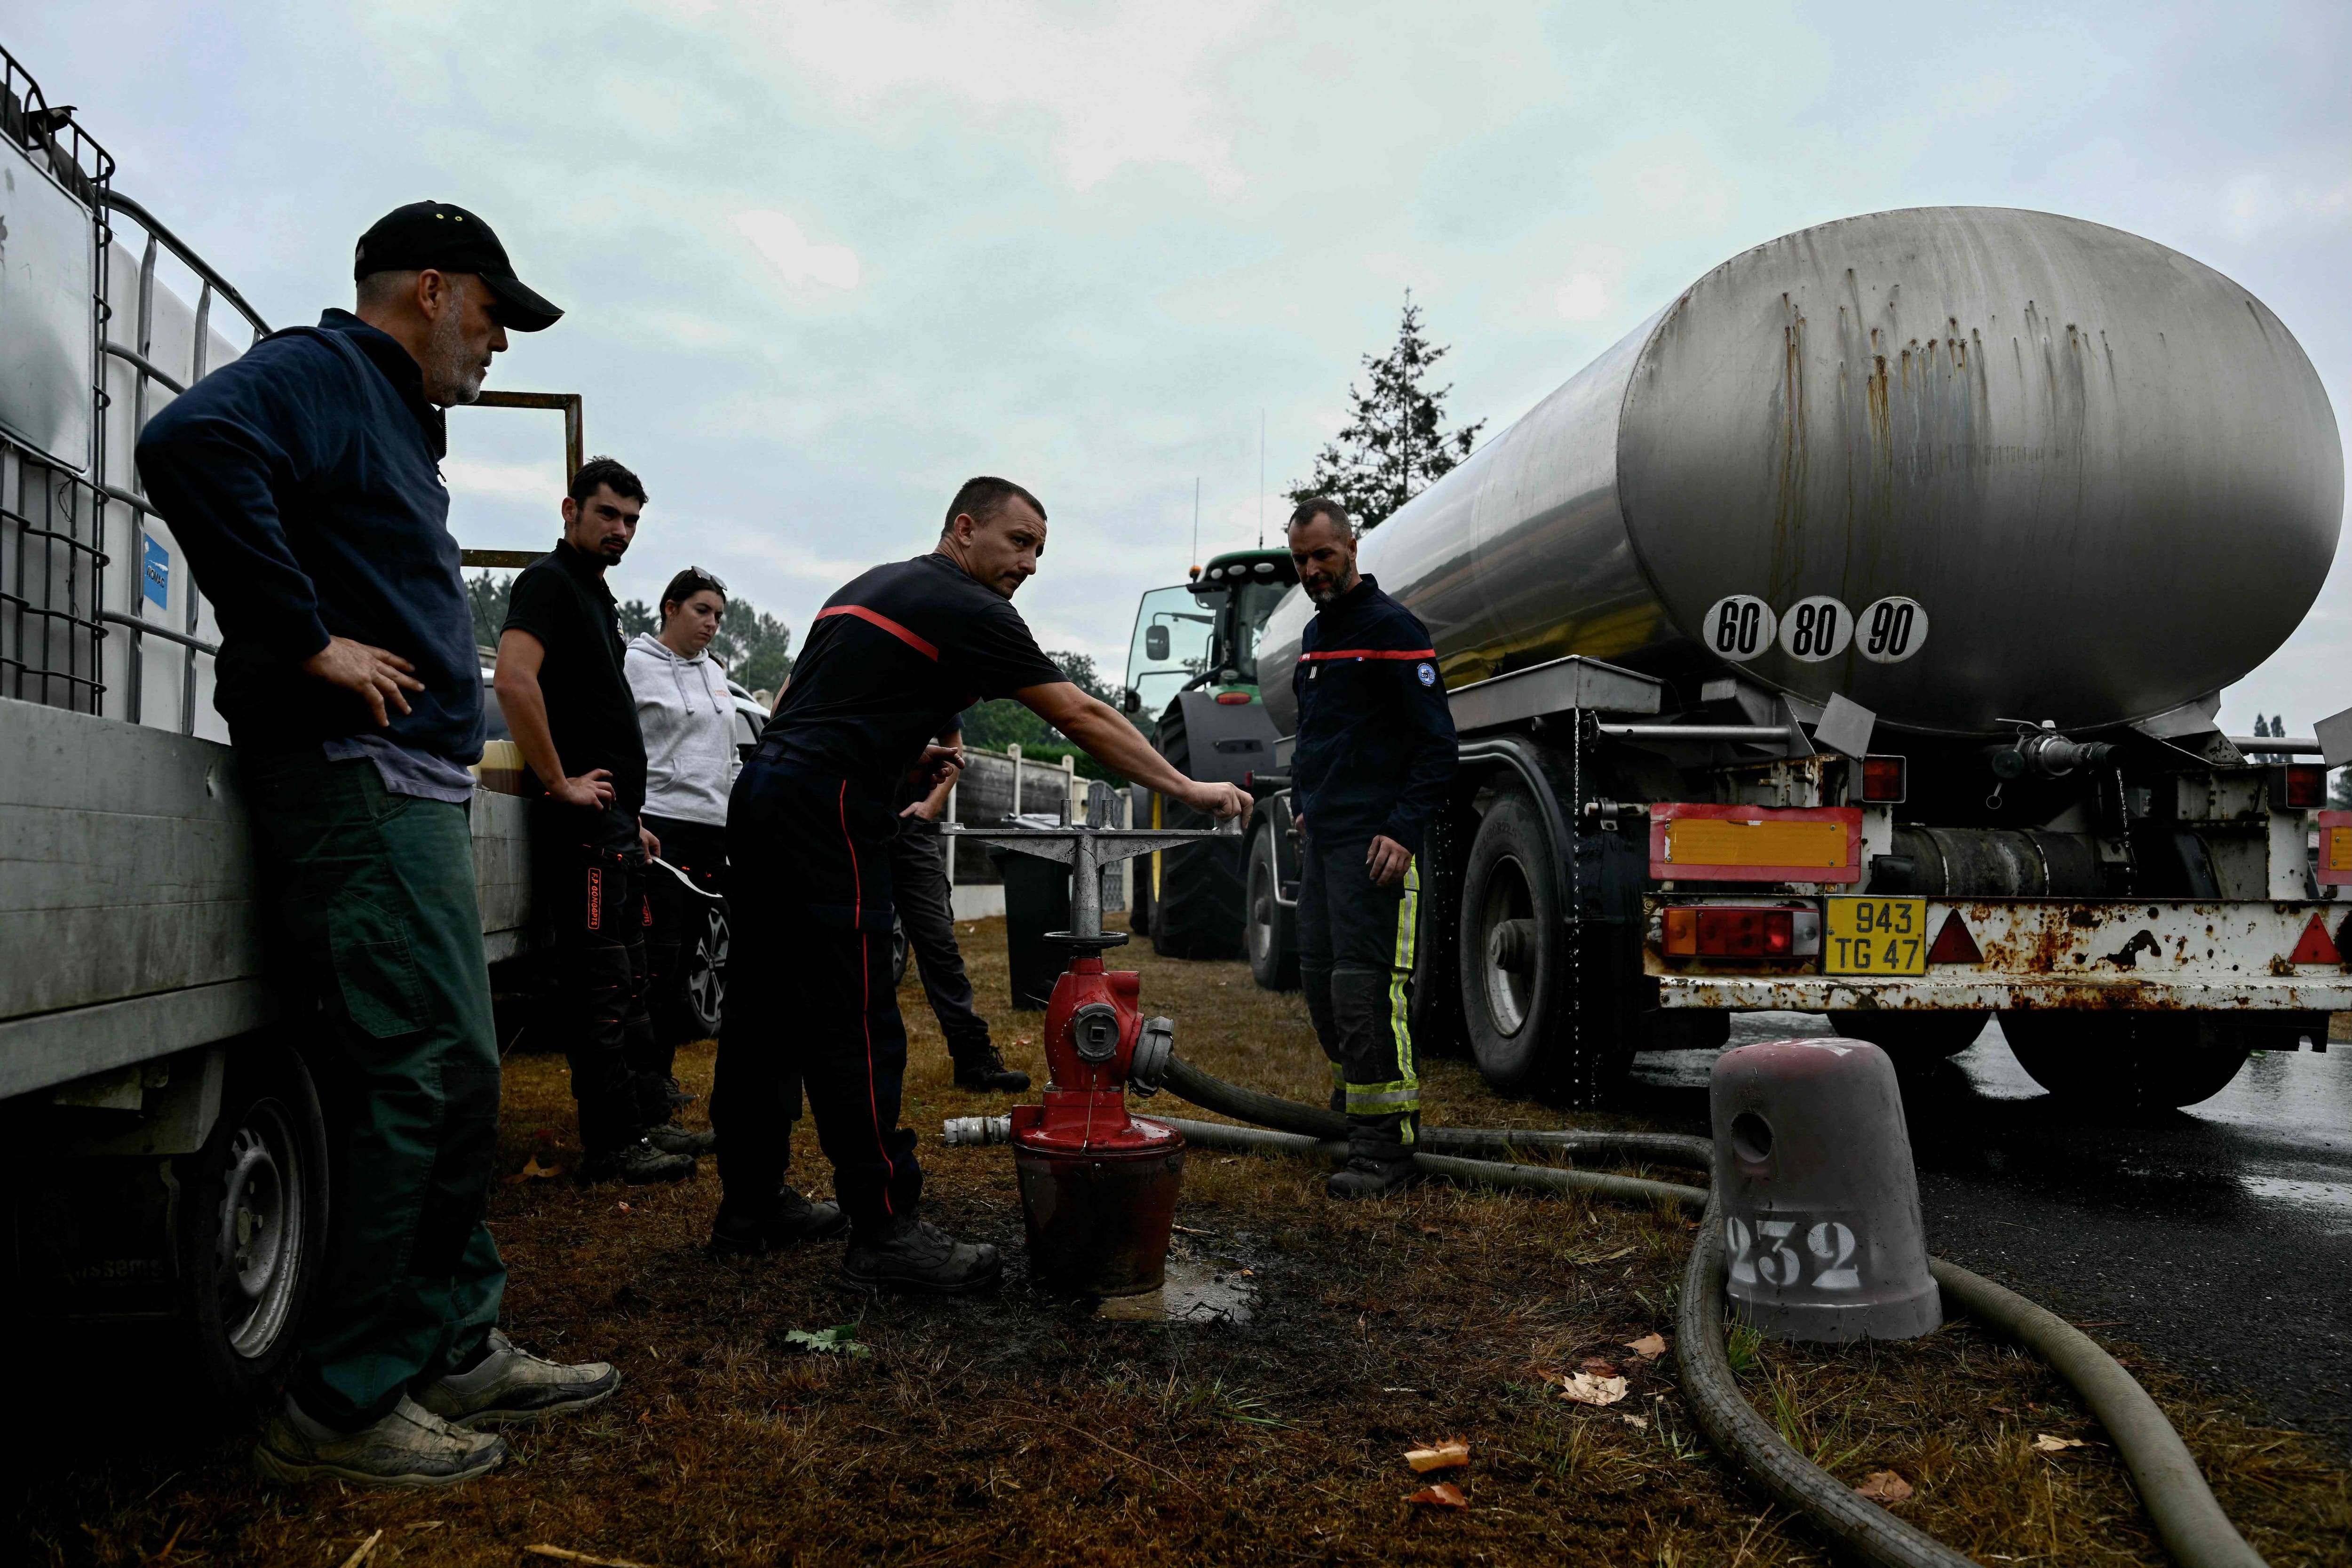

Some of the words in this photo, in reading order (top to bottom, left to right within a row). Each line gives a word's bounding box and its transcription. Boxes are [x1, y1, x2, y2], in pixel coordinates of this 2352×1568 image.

[1716, 601, 1760, 654] 60
[1793, 604, 1837, 656] 80
[1868, 602, 1914, 656] 90
[1856, 902, 1912, 934] 943
[1835, 938, 1871, 969] TG
[1883, 939, 1919, 970] 47
